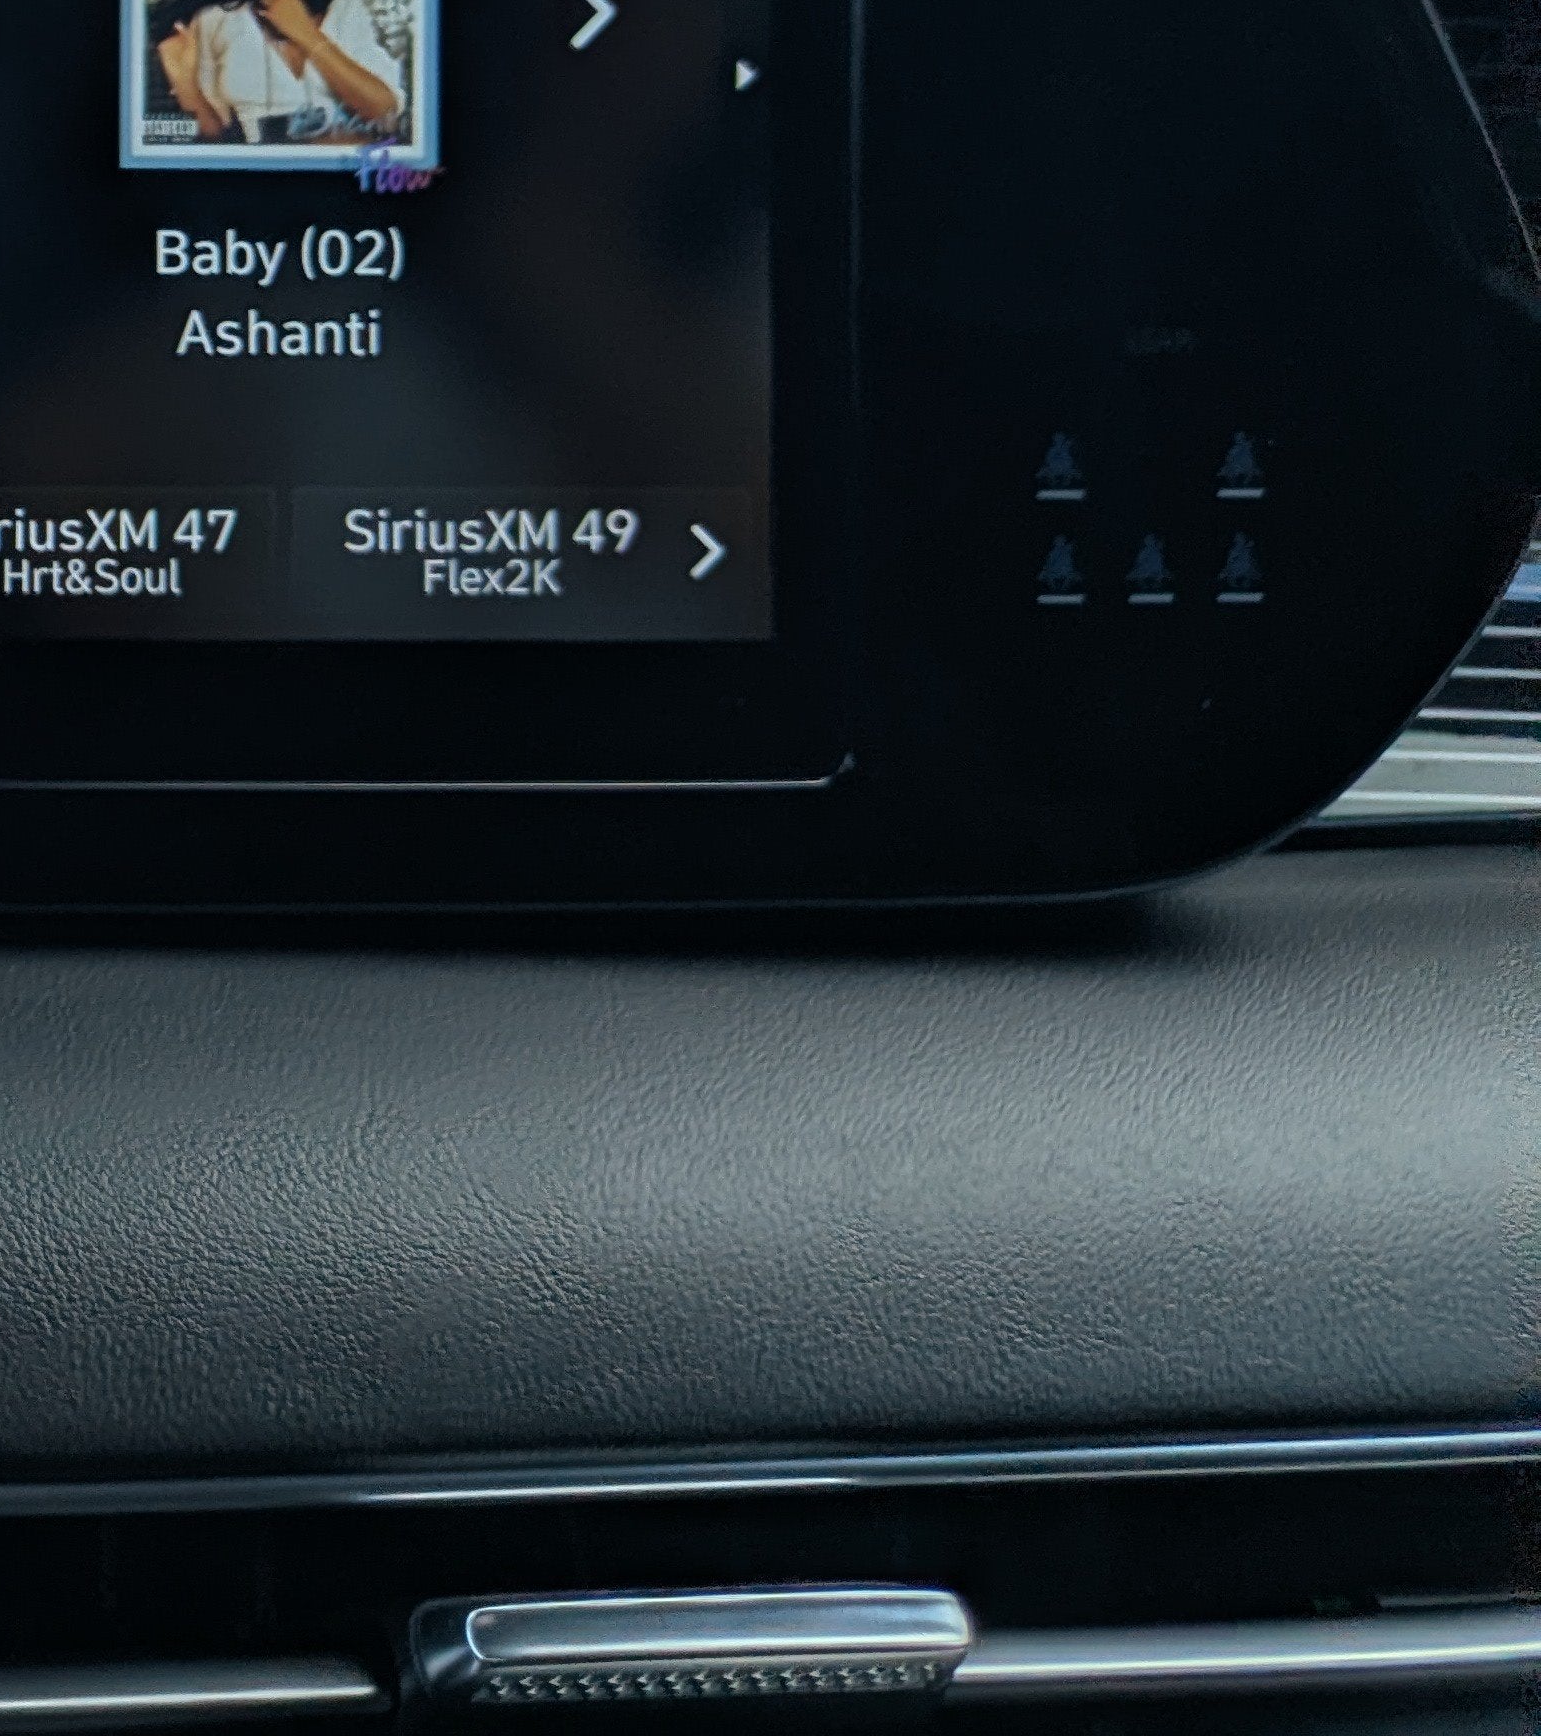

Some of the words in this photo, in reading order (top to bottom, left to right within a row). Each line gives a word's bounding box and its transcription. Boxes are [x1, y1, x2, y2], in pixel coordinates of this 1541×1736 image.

[154, 228, 288, 288] Baby
[301, 226, 405, 282] (02)
[175, 309, 382, 357] Ashanti
[174, 508, 238, 552] 47
[343, 509, 559, 552] SiriusXM
[573, 508, 640, 553] 49
[2, 557, 183, 596] Hrt&Soul
[422, 558, 562, 595] Flex2K
